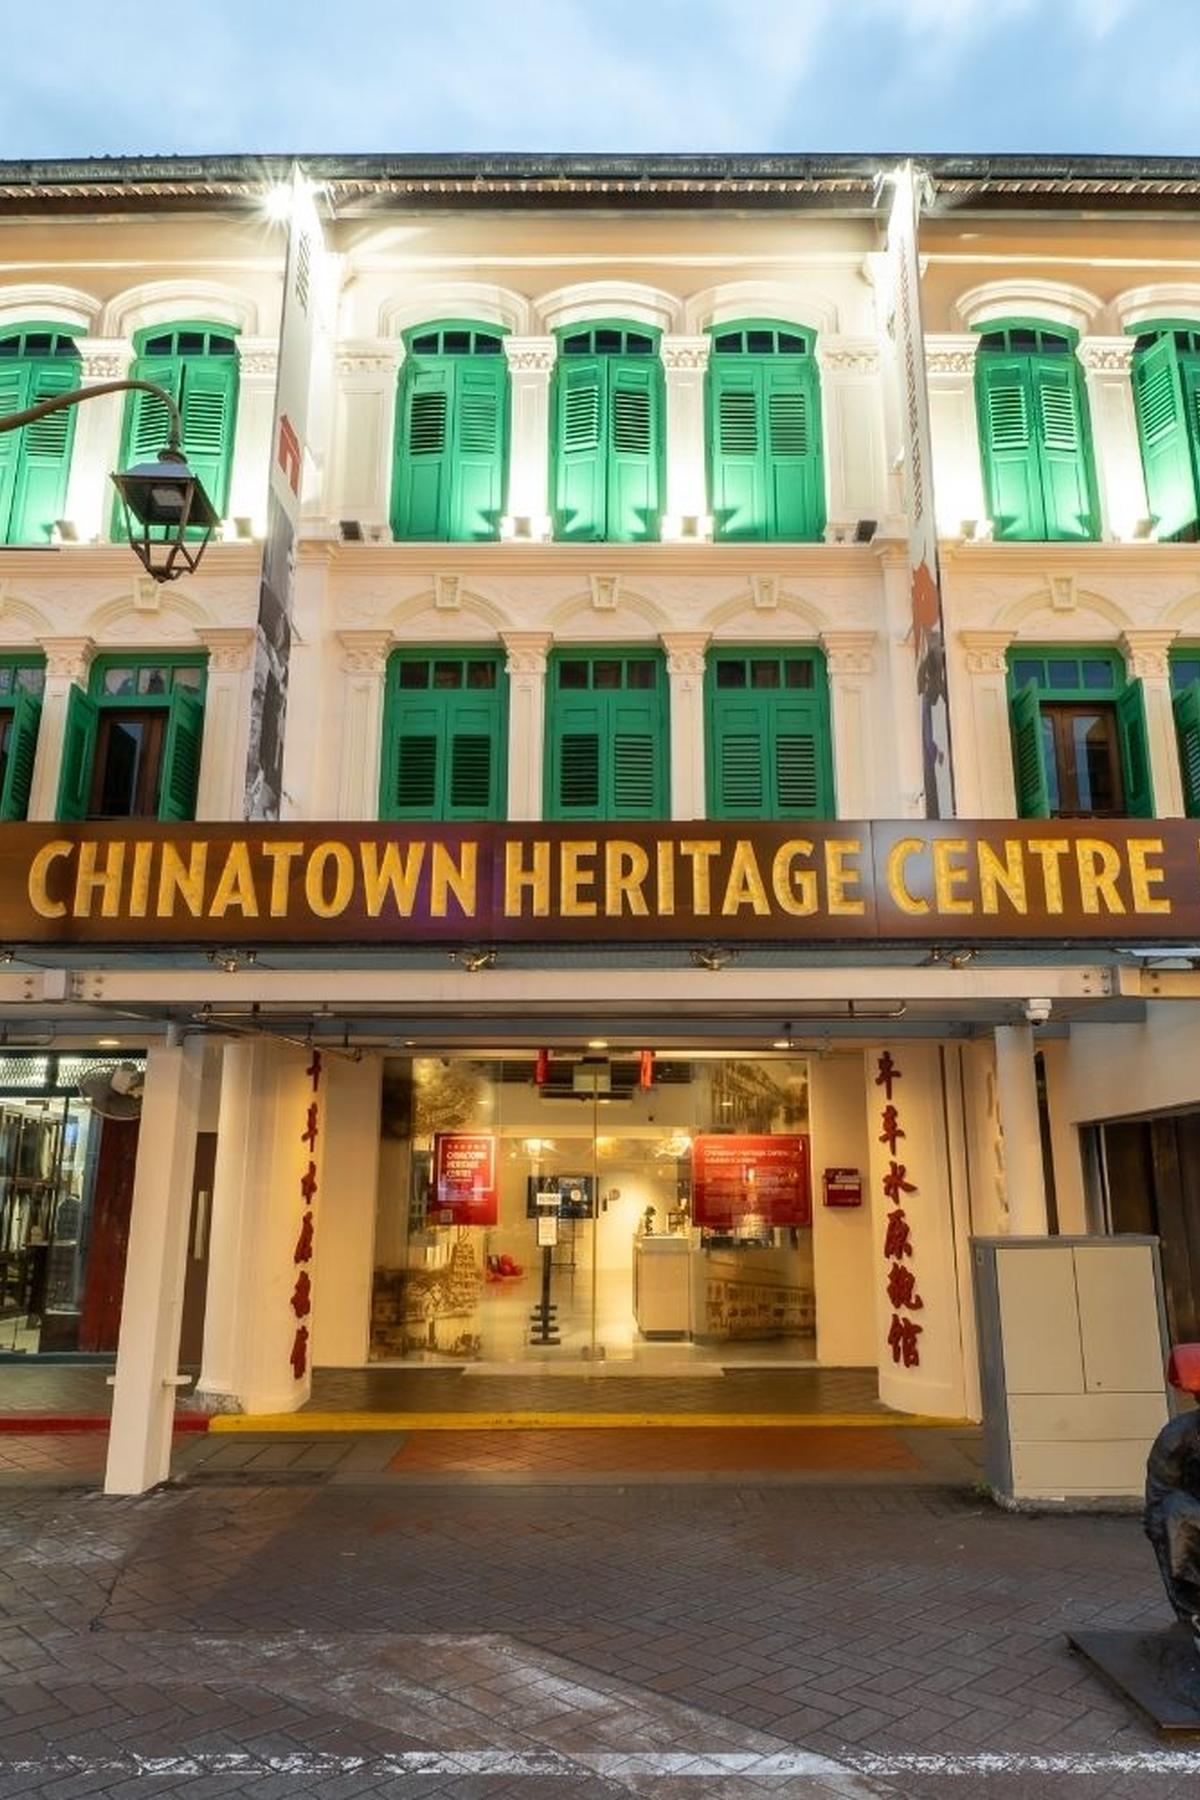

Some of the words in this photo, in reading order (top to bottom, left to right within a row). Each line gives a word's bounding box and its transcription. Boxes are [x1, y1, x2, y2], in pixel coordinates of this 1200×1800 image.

[28, 840, 478, 918] CHINATOWN
[504, 839, 865, 917] HERITAGE
[885, 838, 1171, 915] CENTRE
